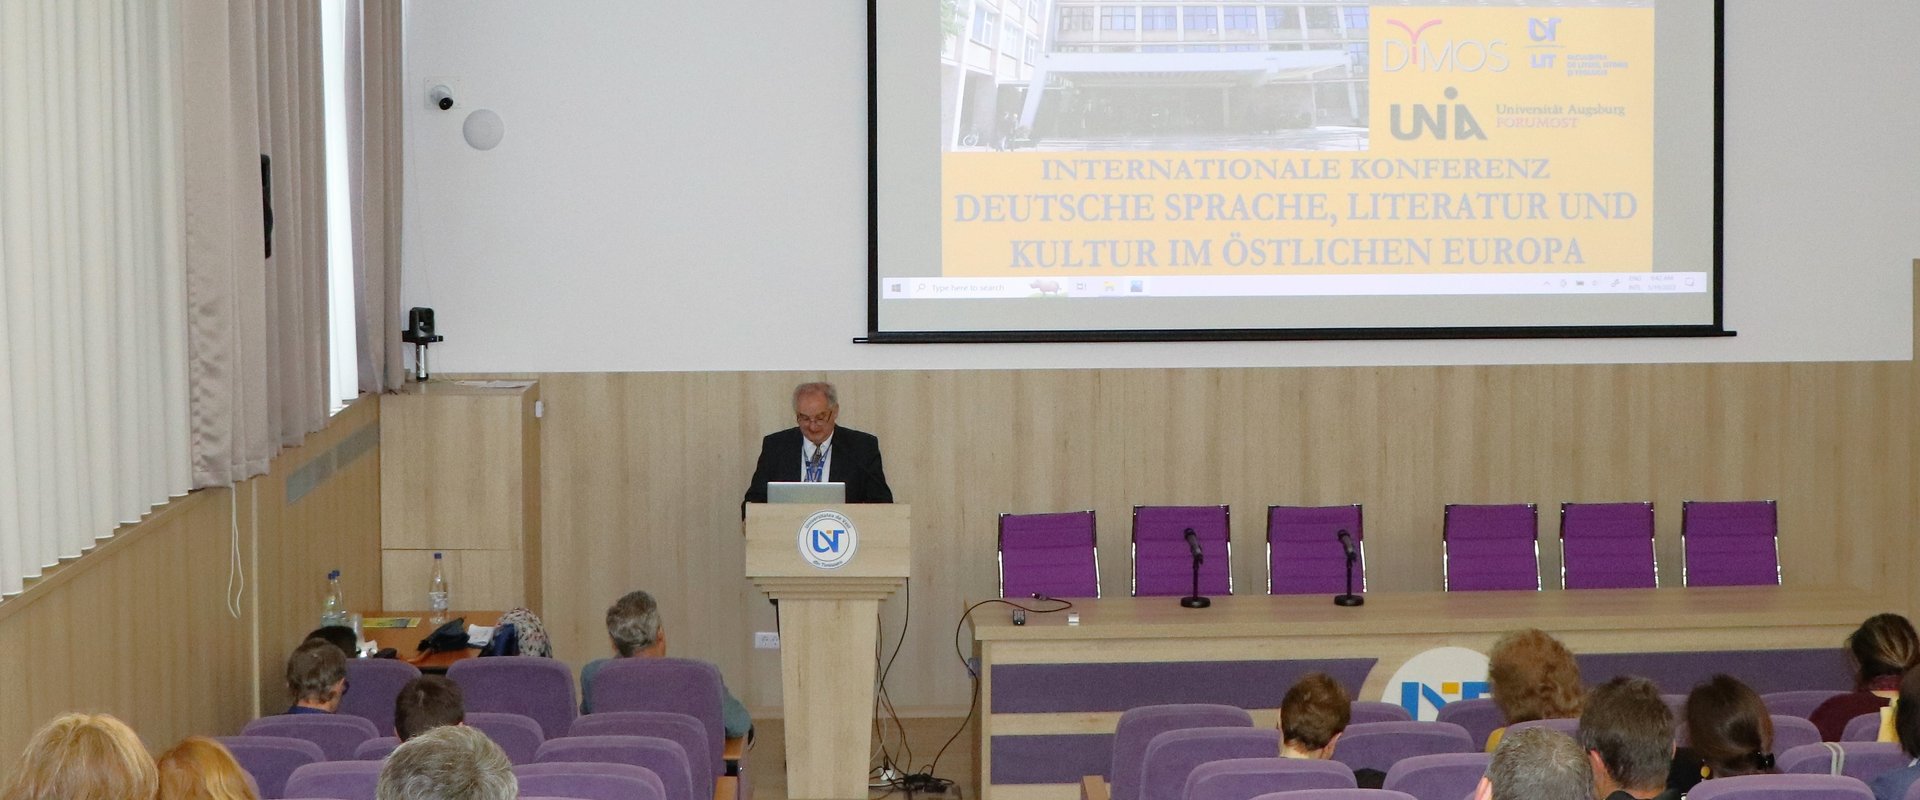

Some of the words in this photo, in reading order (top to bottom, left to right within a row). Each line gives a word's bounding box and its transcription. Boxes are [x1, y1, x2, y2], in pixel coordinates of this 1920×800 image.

[1496, 104, 1563, 115] Universität
[1568, 103, 1626, 117] Augsburg
[1496, 117, 1578, 129] FORUMOST
[1041, 159, 1340, 180] INTERNATIONALE
[1350, 158, 1551, 179] KONFERENZ
[954, 193, 1155, 222] DEUTSCHE
[1165, 193, 1338, 227] SPRACHE,
[1346, 192, 1550, 220] LITERATUR
[1557, 191, 1638, 220] UND
[1009, 239, 1159, 268] KULTUR
[1167, 239, 1213, 267] IM
[1222, 231, 1433, 267] ÖSTLICHEN
[1441, 237, 1586, 265] EUROPA
[932, 284, 949, 293] Type
